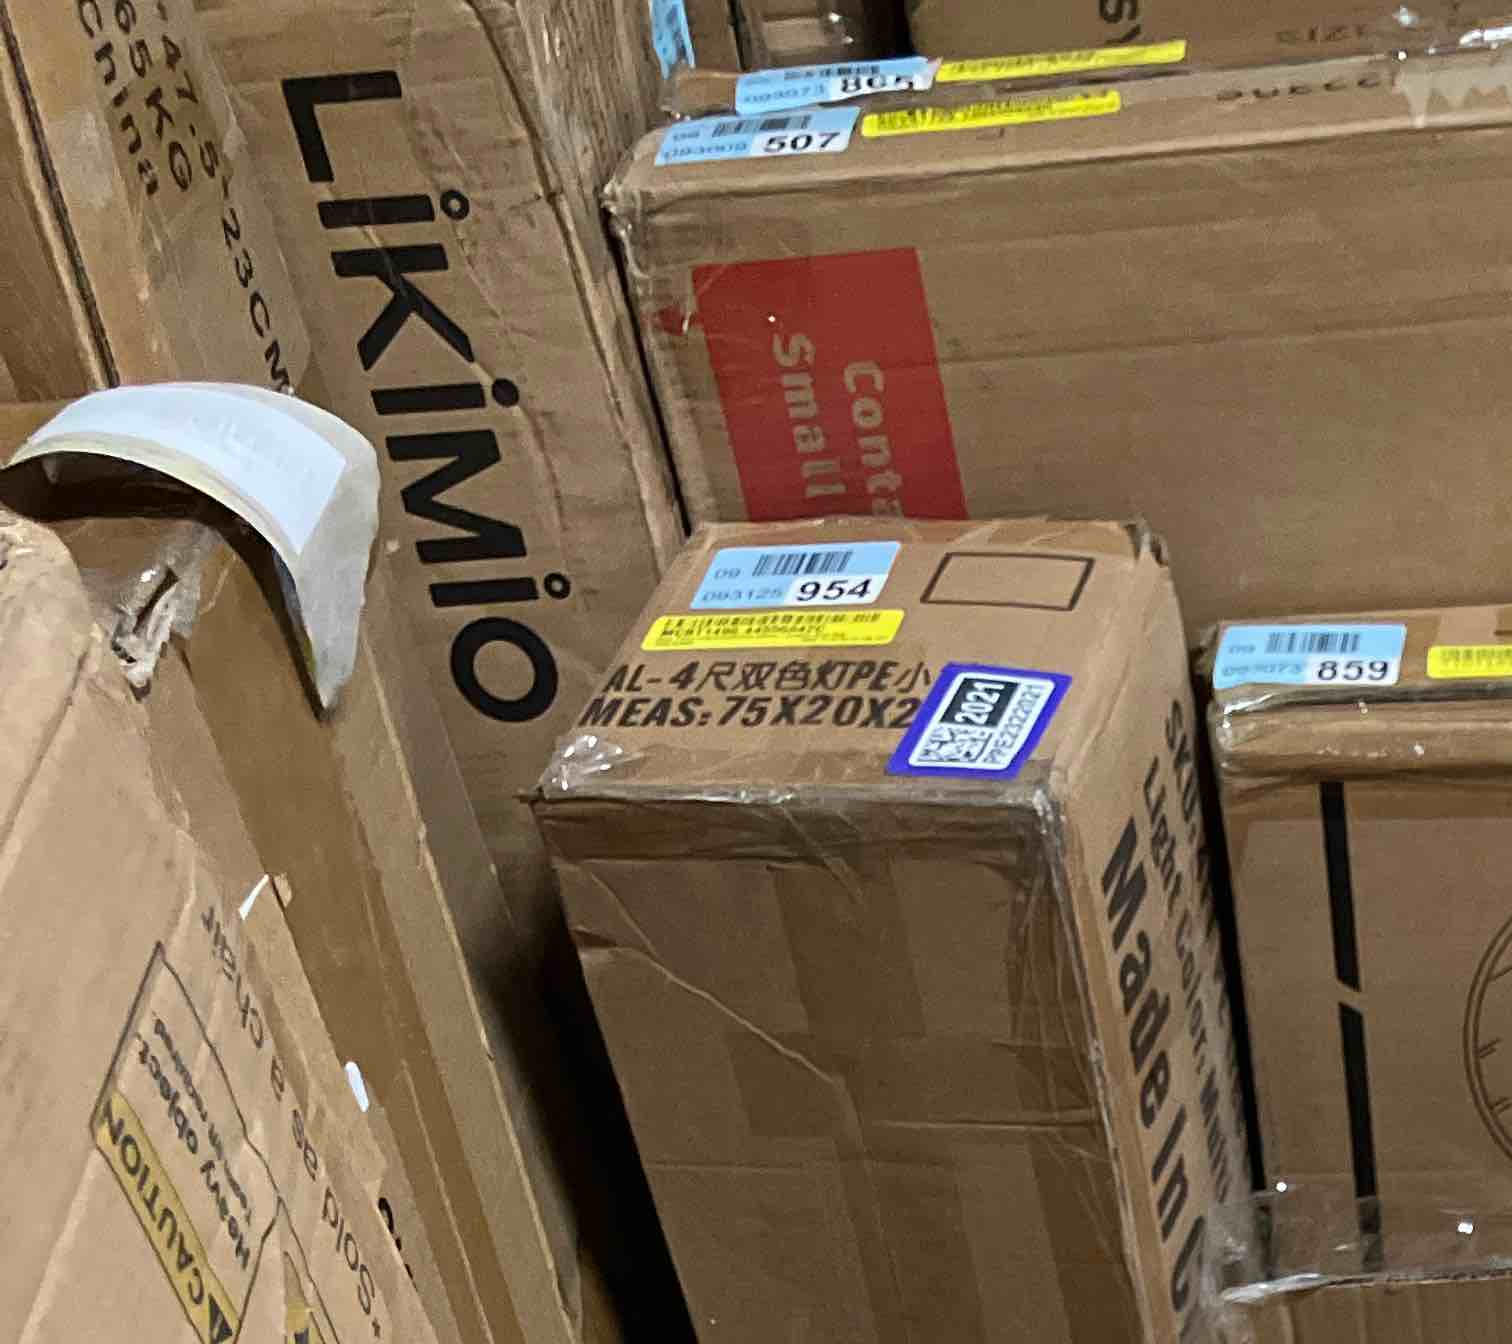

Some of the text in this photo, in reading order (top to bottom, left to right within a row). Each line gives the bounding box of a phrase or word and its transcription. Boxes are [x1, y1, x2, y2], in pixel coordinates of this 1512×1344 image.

[762, 131, 841, 154] 507
[772, 332, 848, 498] Small
[794, 578, 872, 602] 954
[954, 681, 1005, 725] 2021
[1316, 660, 1390, 682] 859
[1142, 754, 1184, 918] Light
[200, 905, 266, 1050] chair
[1101, 815, 1188, 1243] Made In
[269, 1055, 288, 1101] a
[290, 1108, 320, 1182] as
[100, 1099, 207, 1308] CAUTION
[200, 1158, 253, 1272] Heavy
